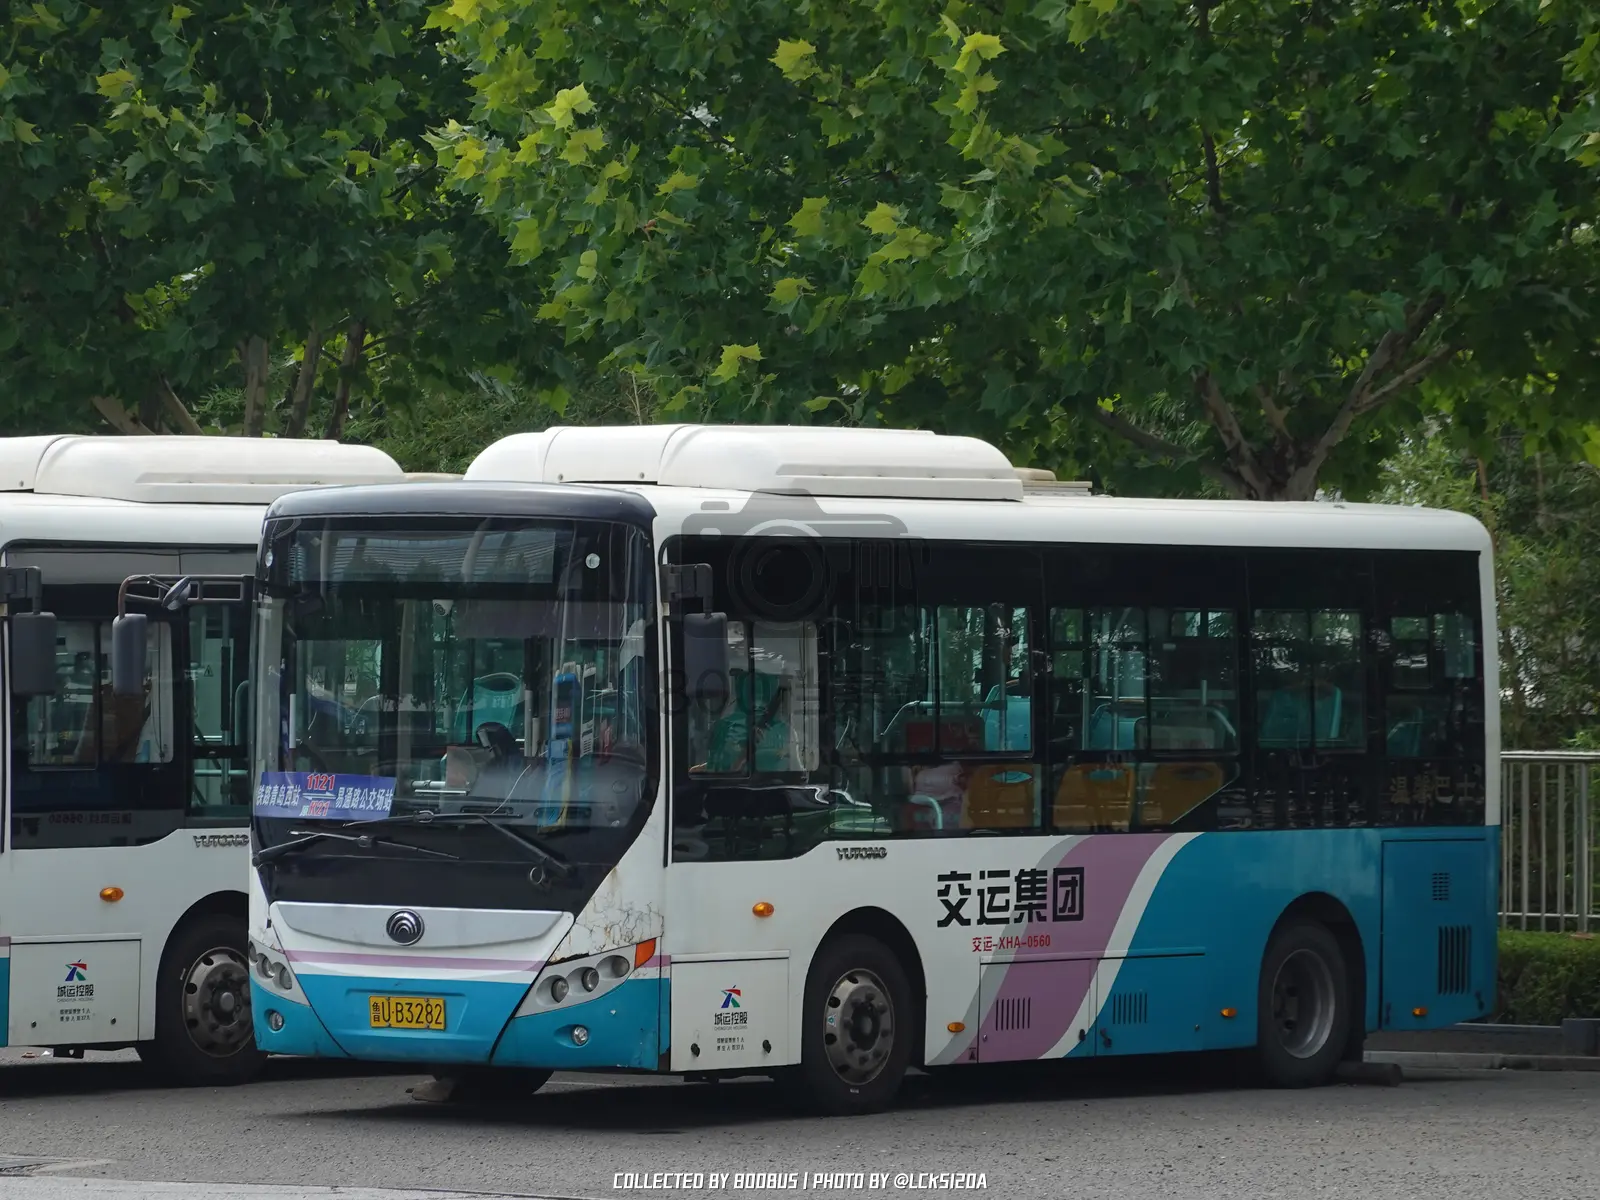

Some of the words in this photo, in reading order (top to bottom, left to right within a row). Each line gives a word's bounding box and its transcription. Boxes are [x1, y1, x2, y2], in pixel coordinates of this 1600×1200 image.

[307, 773, 336, 791] 1121
[256, 784, 302, 807] 铁路青岛西站
[335, 786, 394, 812] 易通路公交场站
[836, 846, 888, 861] YUTONG
[937, 866, 1085, 928] 交运集团
[972, 934, 1051, 952] 交运-XHA-0560
[56, 984, 94, 997] 城运控股
[714, 1011, 748, 1025] 城运控股
